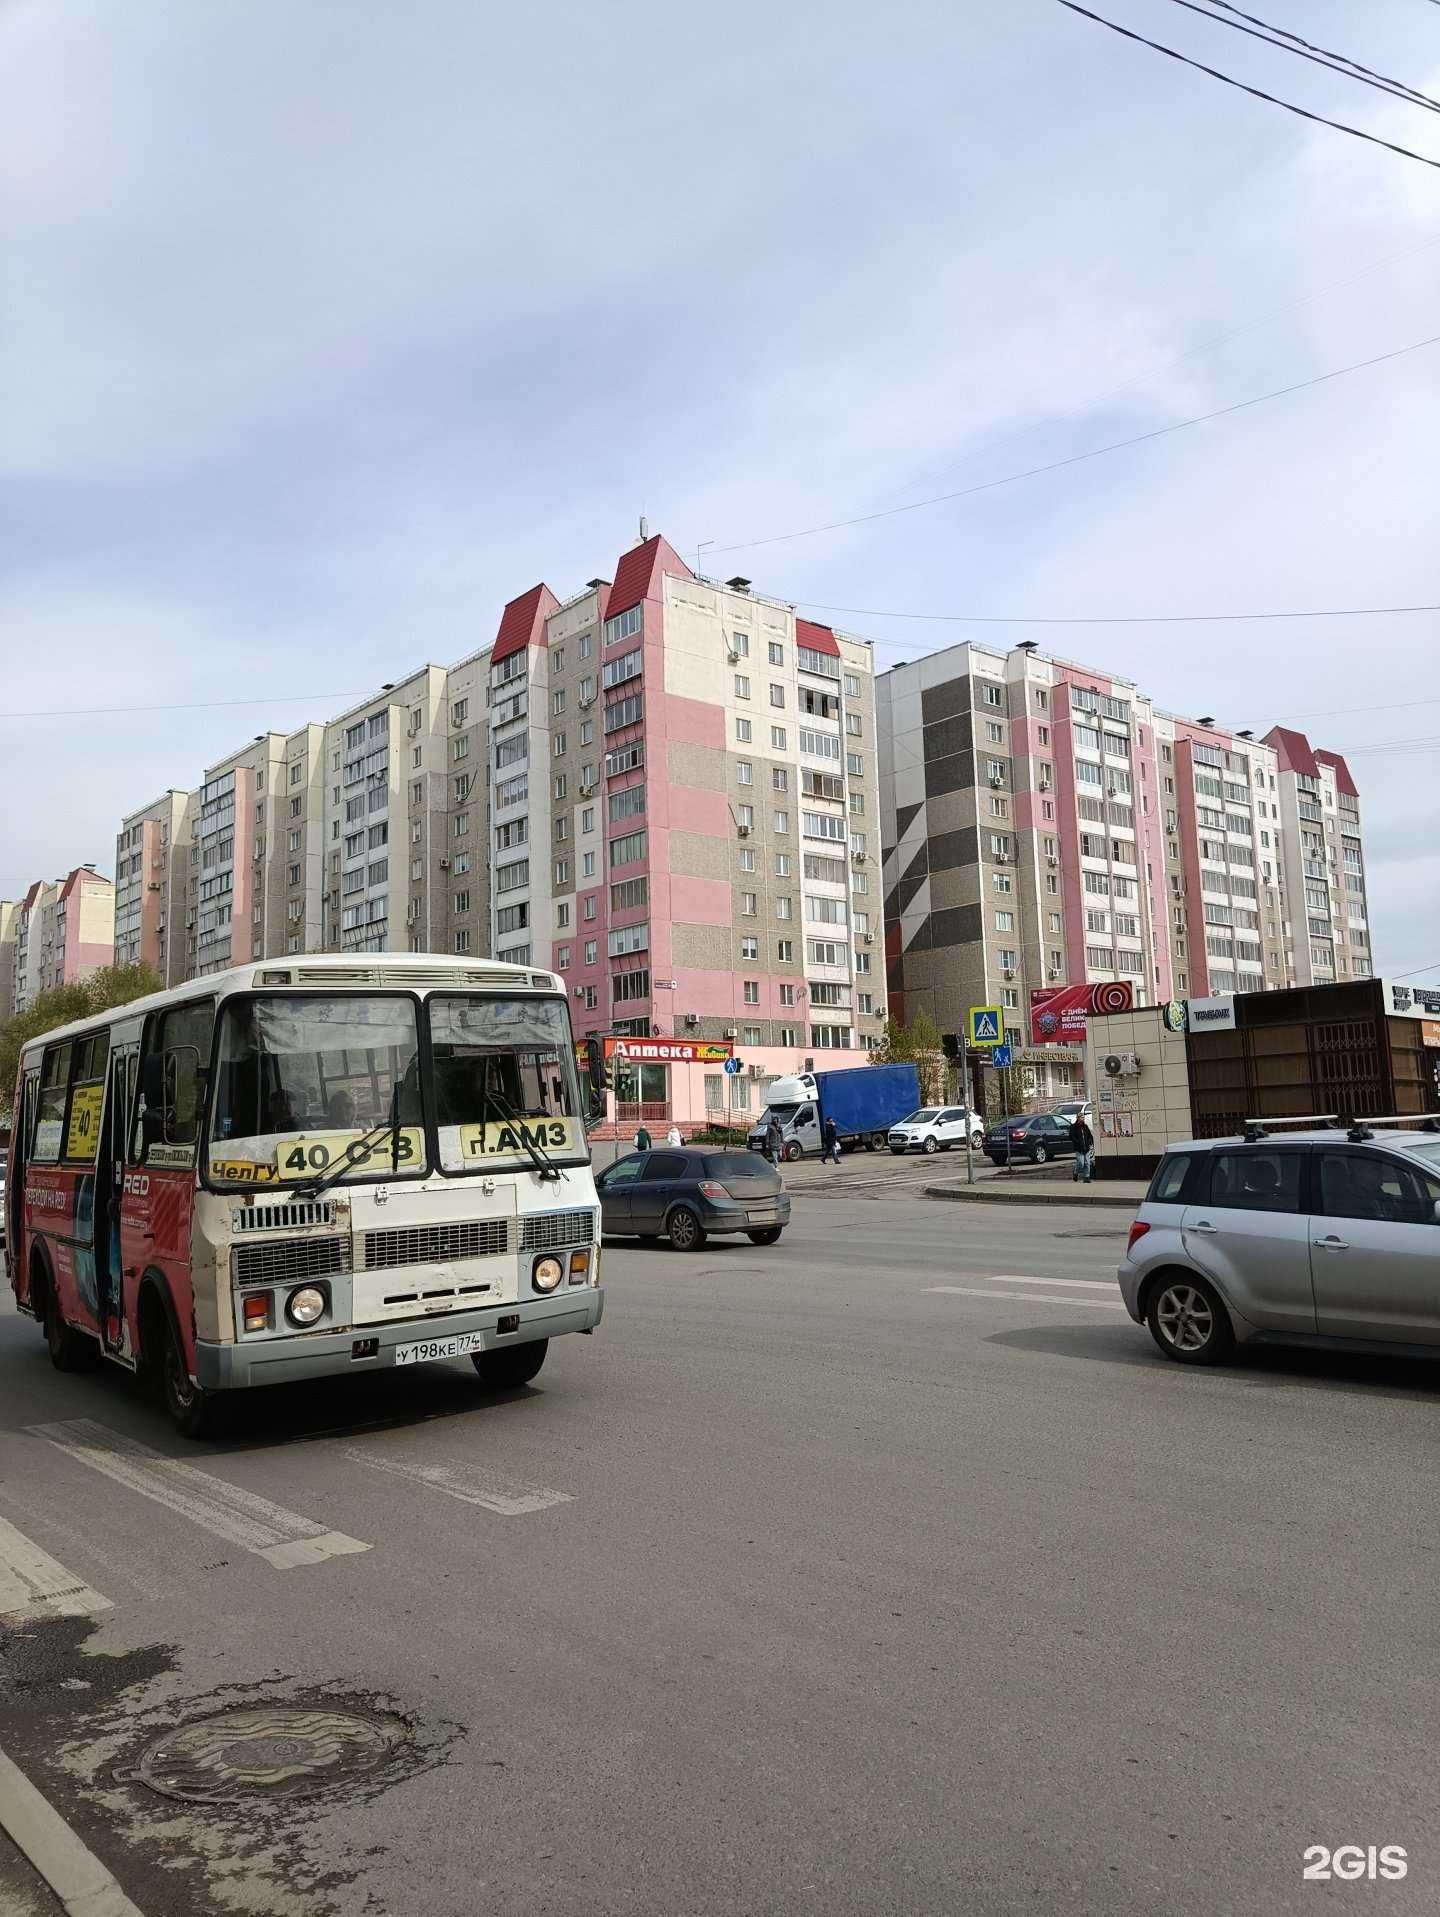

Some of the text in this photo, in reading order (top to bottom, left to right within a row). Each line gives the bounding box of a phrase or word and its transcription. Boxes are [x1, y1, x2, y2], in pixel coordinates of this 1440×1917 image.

[1062, 1021, 1086, 1029] ПОБЕД
[615, 1041, 693, 1058] Аптека
[78, 1109, 91, 1136] 40
[285, 1144, 330, 1171] 40
[213, 1162, 279, 1180] ЧелГУ
[123, 1174, 150, 1196] RED
